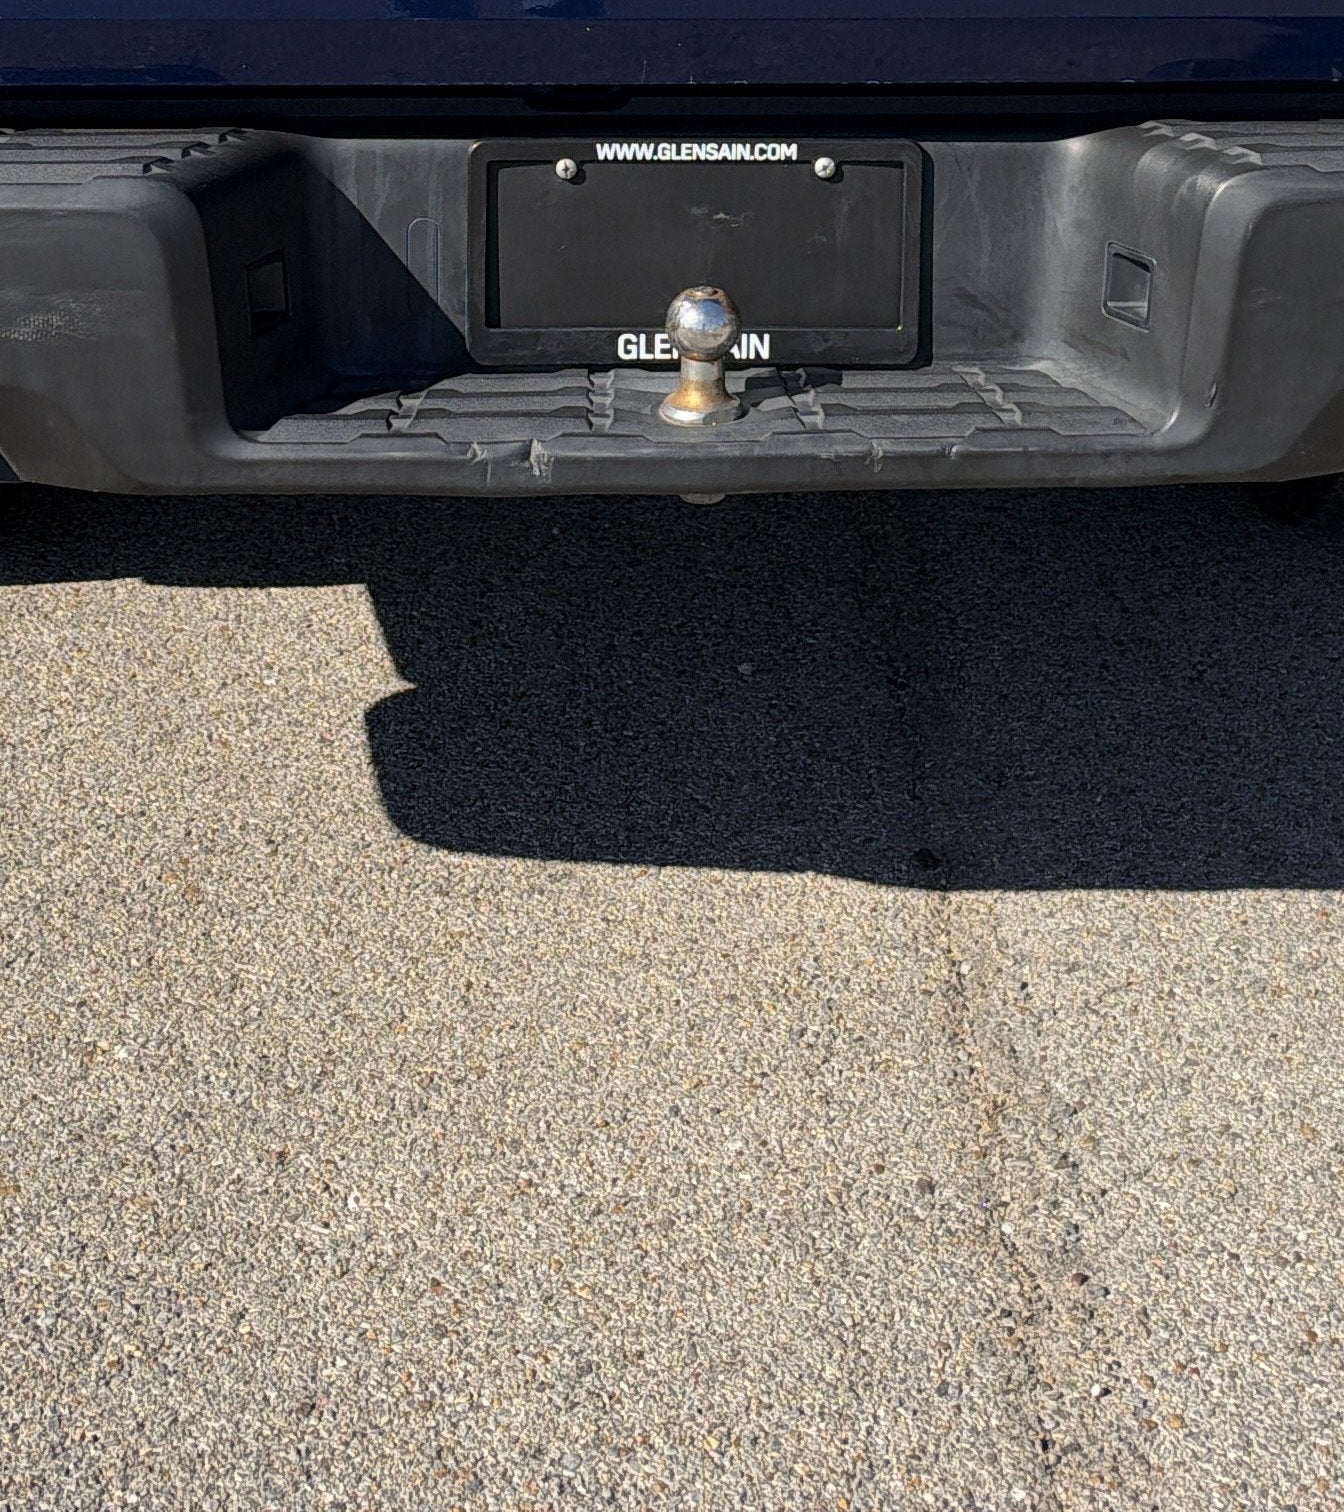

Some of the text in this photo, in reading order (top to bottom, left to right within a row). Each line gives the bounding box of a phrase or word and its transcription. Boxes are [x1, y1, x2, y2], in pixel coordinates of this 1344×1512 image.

[595, 143, 798, 161] WWW.GLENSAIN.COM
[617, 333, 770, 360] GLE IN
